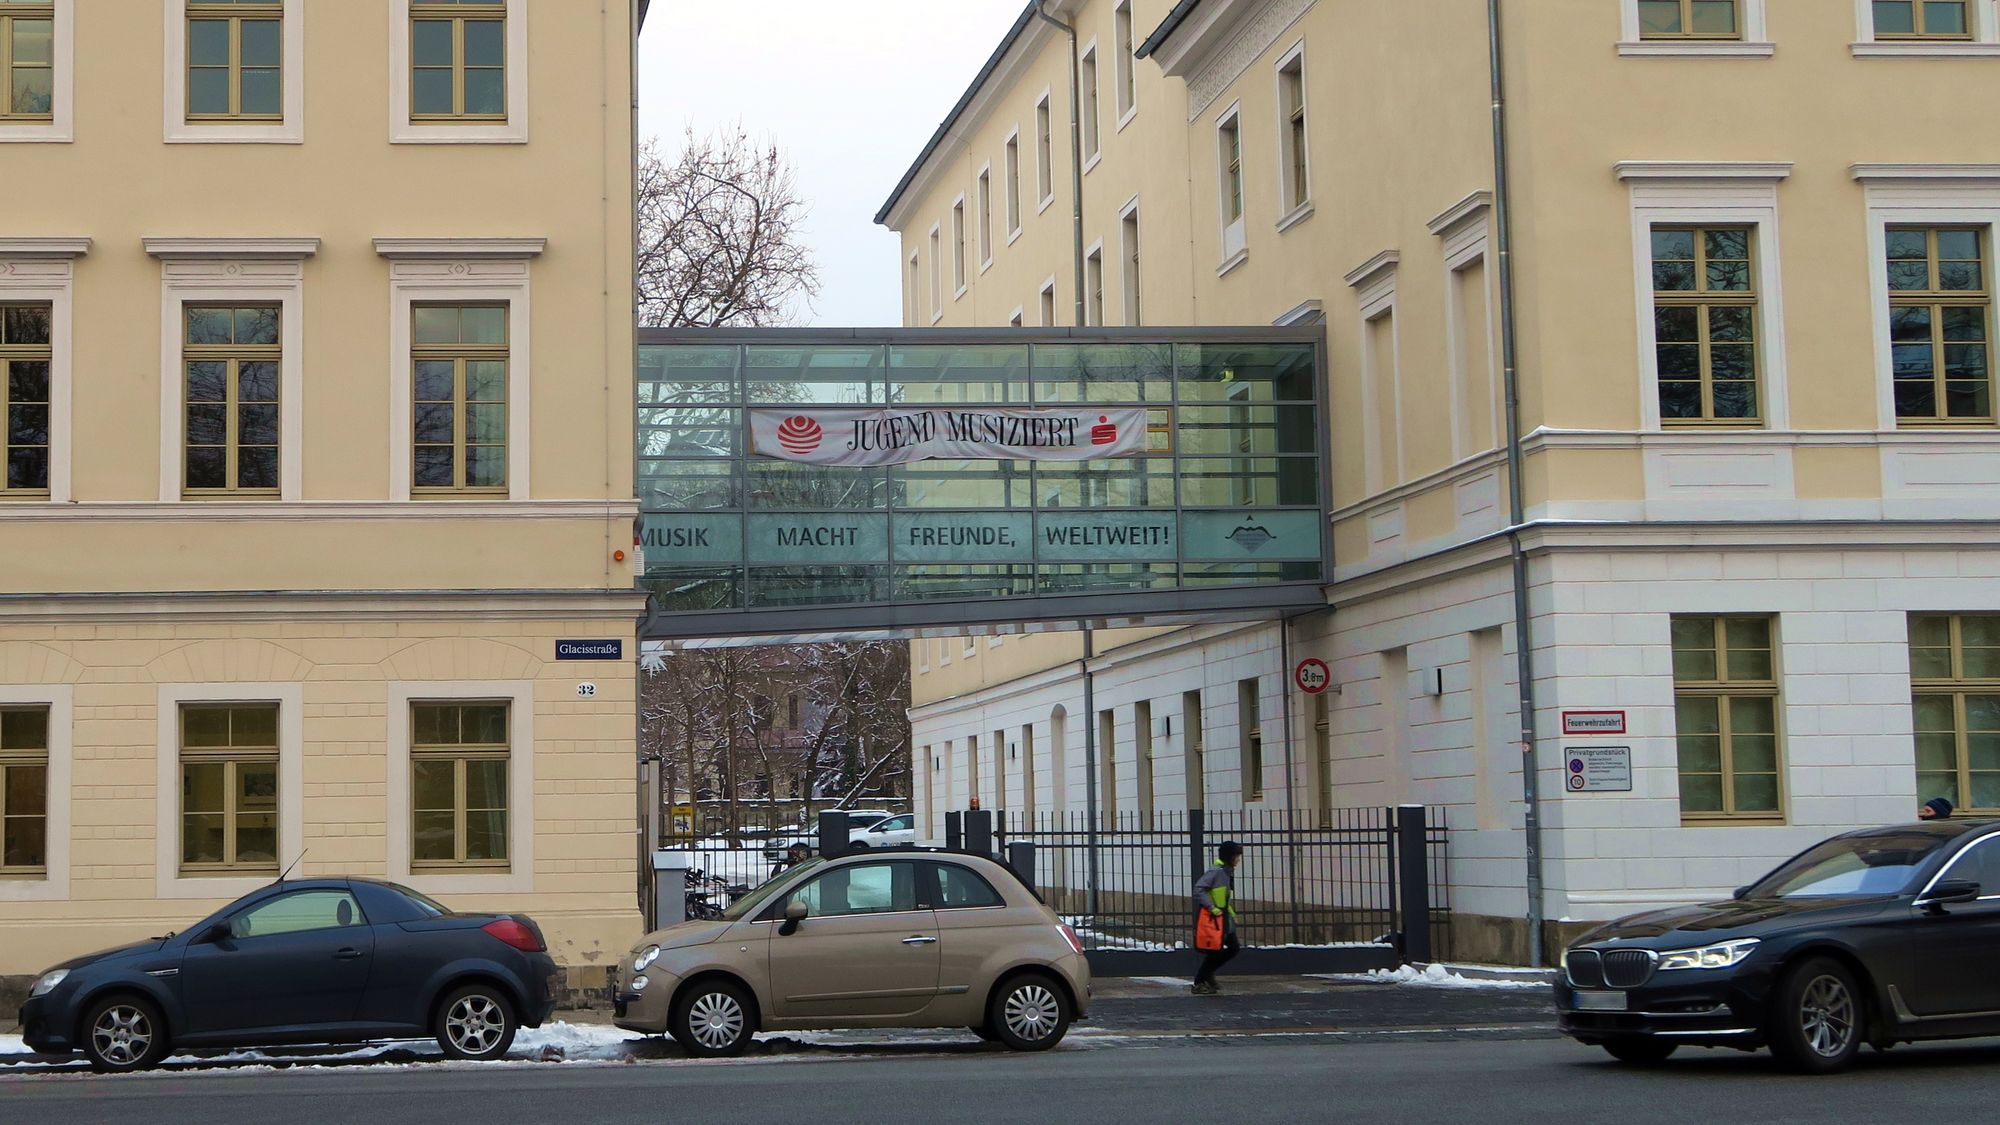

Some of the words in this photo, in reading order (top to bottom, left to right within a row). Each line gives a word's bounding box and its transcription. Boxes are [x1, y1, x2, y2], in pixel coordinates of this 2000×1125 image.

[846, 411, 936, 451] JUGEND
[946, 411, 1079, 447] MUSIZIERT
[640, 527, 709, 547] MUSIK
[777, 527, 858, 546] MACHT
[910, 527, 1016, 548] FREUNDE,
[1046, 526, 1169, 545] WELTWEIT!
[559, 644, 618, 654] Glacisstraße
[578, 685, 594, 695] 32
[1567, 718, 1621, 727] Feuerwehrzufahrt
[1569, 749, 1626, 757] Privatgrundstück
